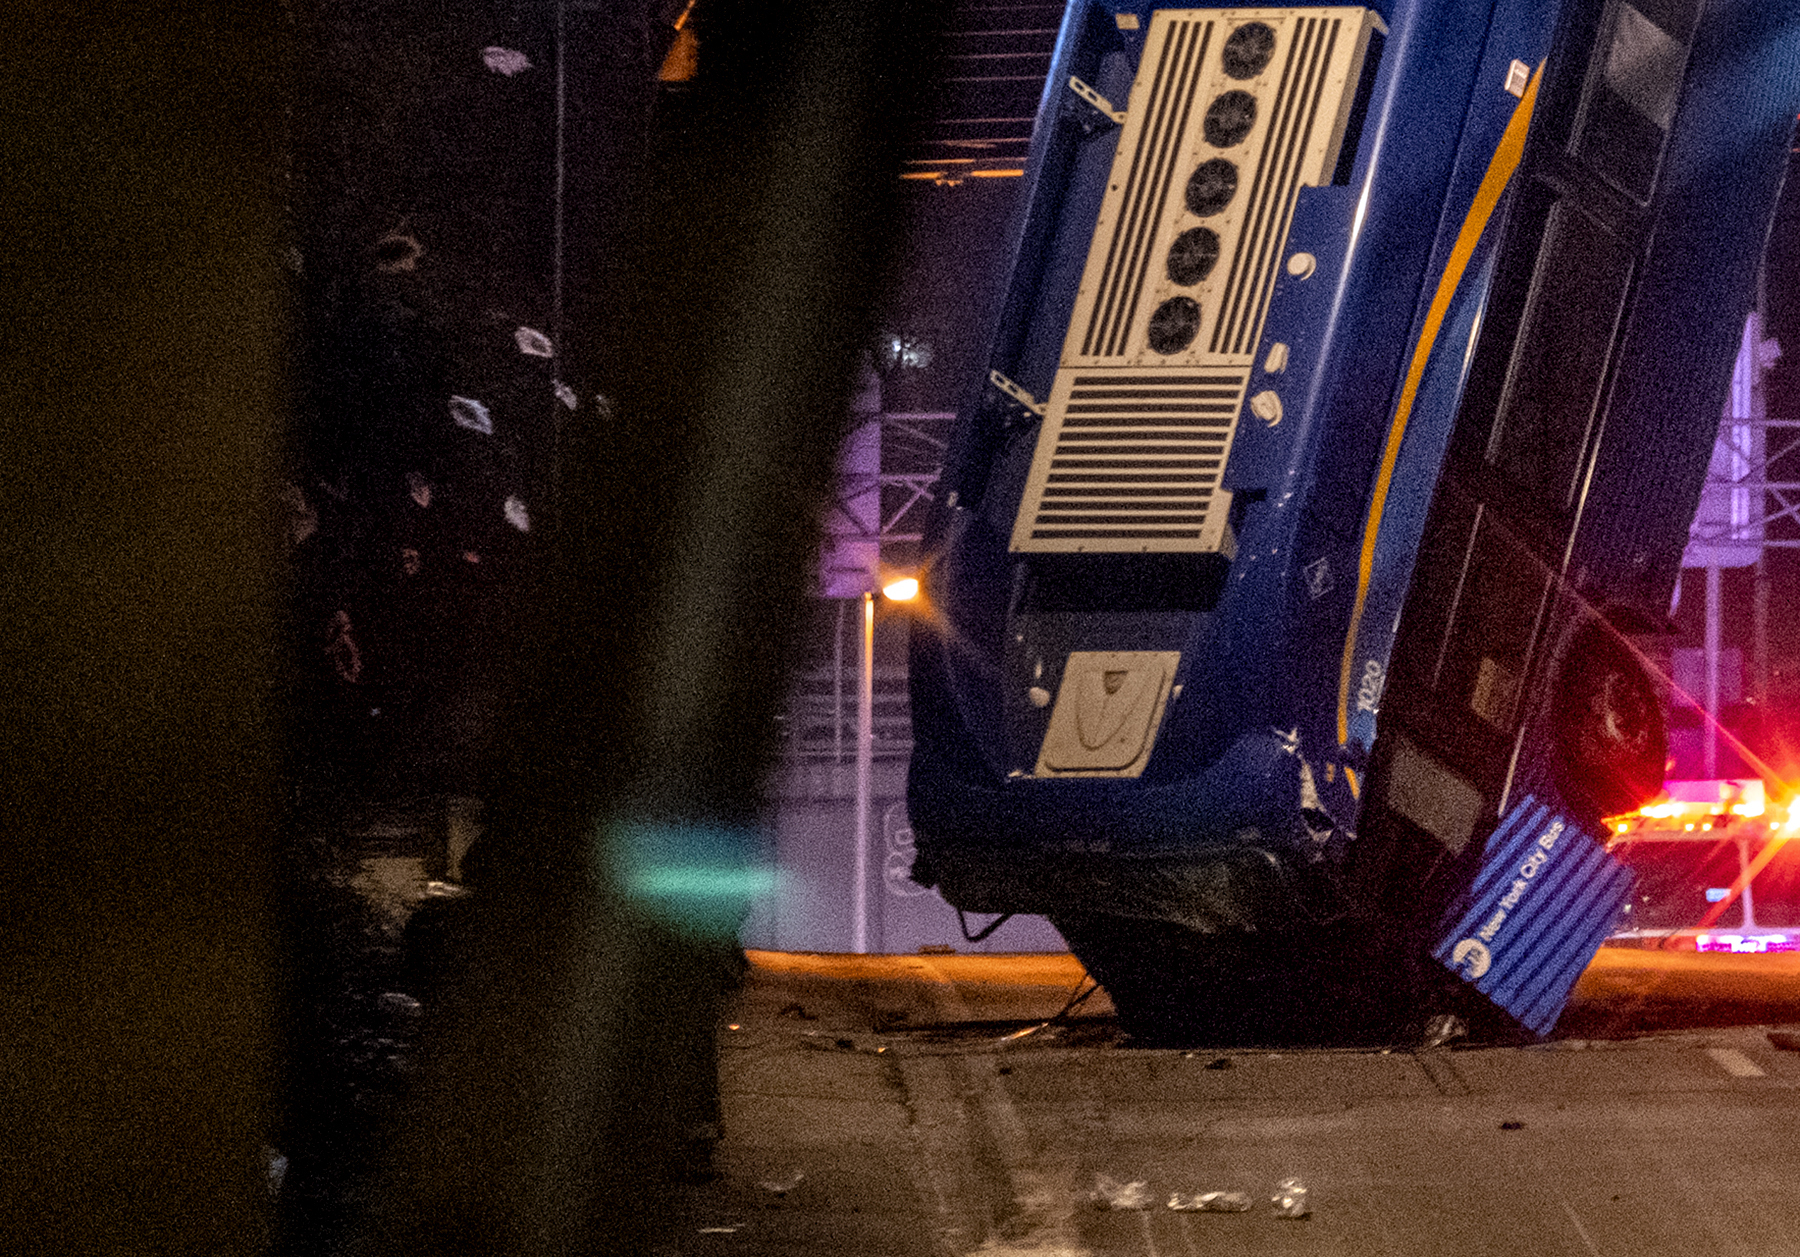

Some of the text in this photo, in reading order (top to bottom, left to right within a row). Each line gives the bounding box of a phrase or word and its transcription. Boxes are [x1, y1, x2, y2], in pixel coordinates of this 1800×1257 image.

[1357, 659, 1383, 712] 1020
[1479, 908, 1506, 942] New
[1500, 879, 1528, 910] York
[1520, 848, 1548, 879] City
[1538, 821, 1565, 850] Bus
